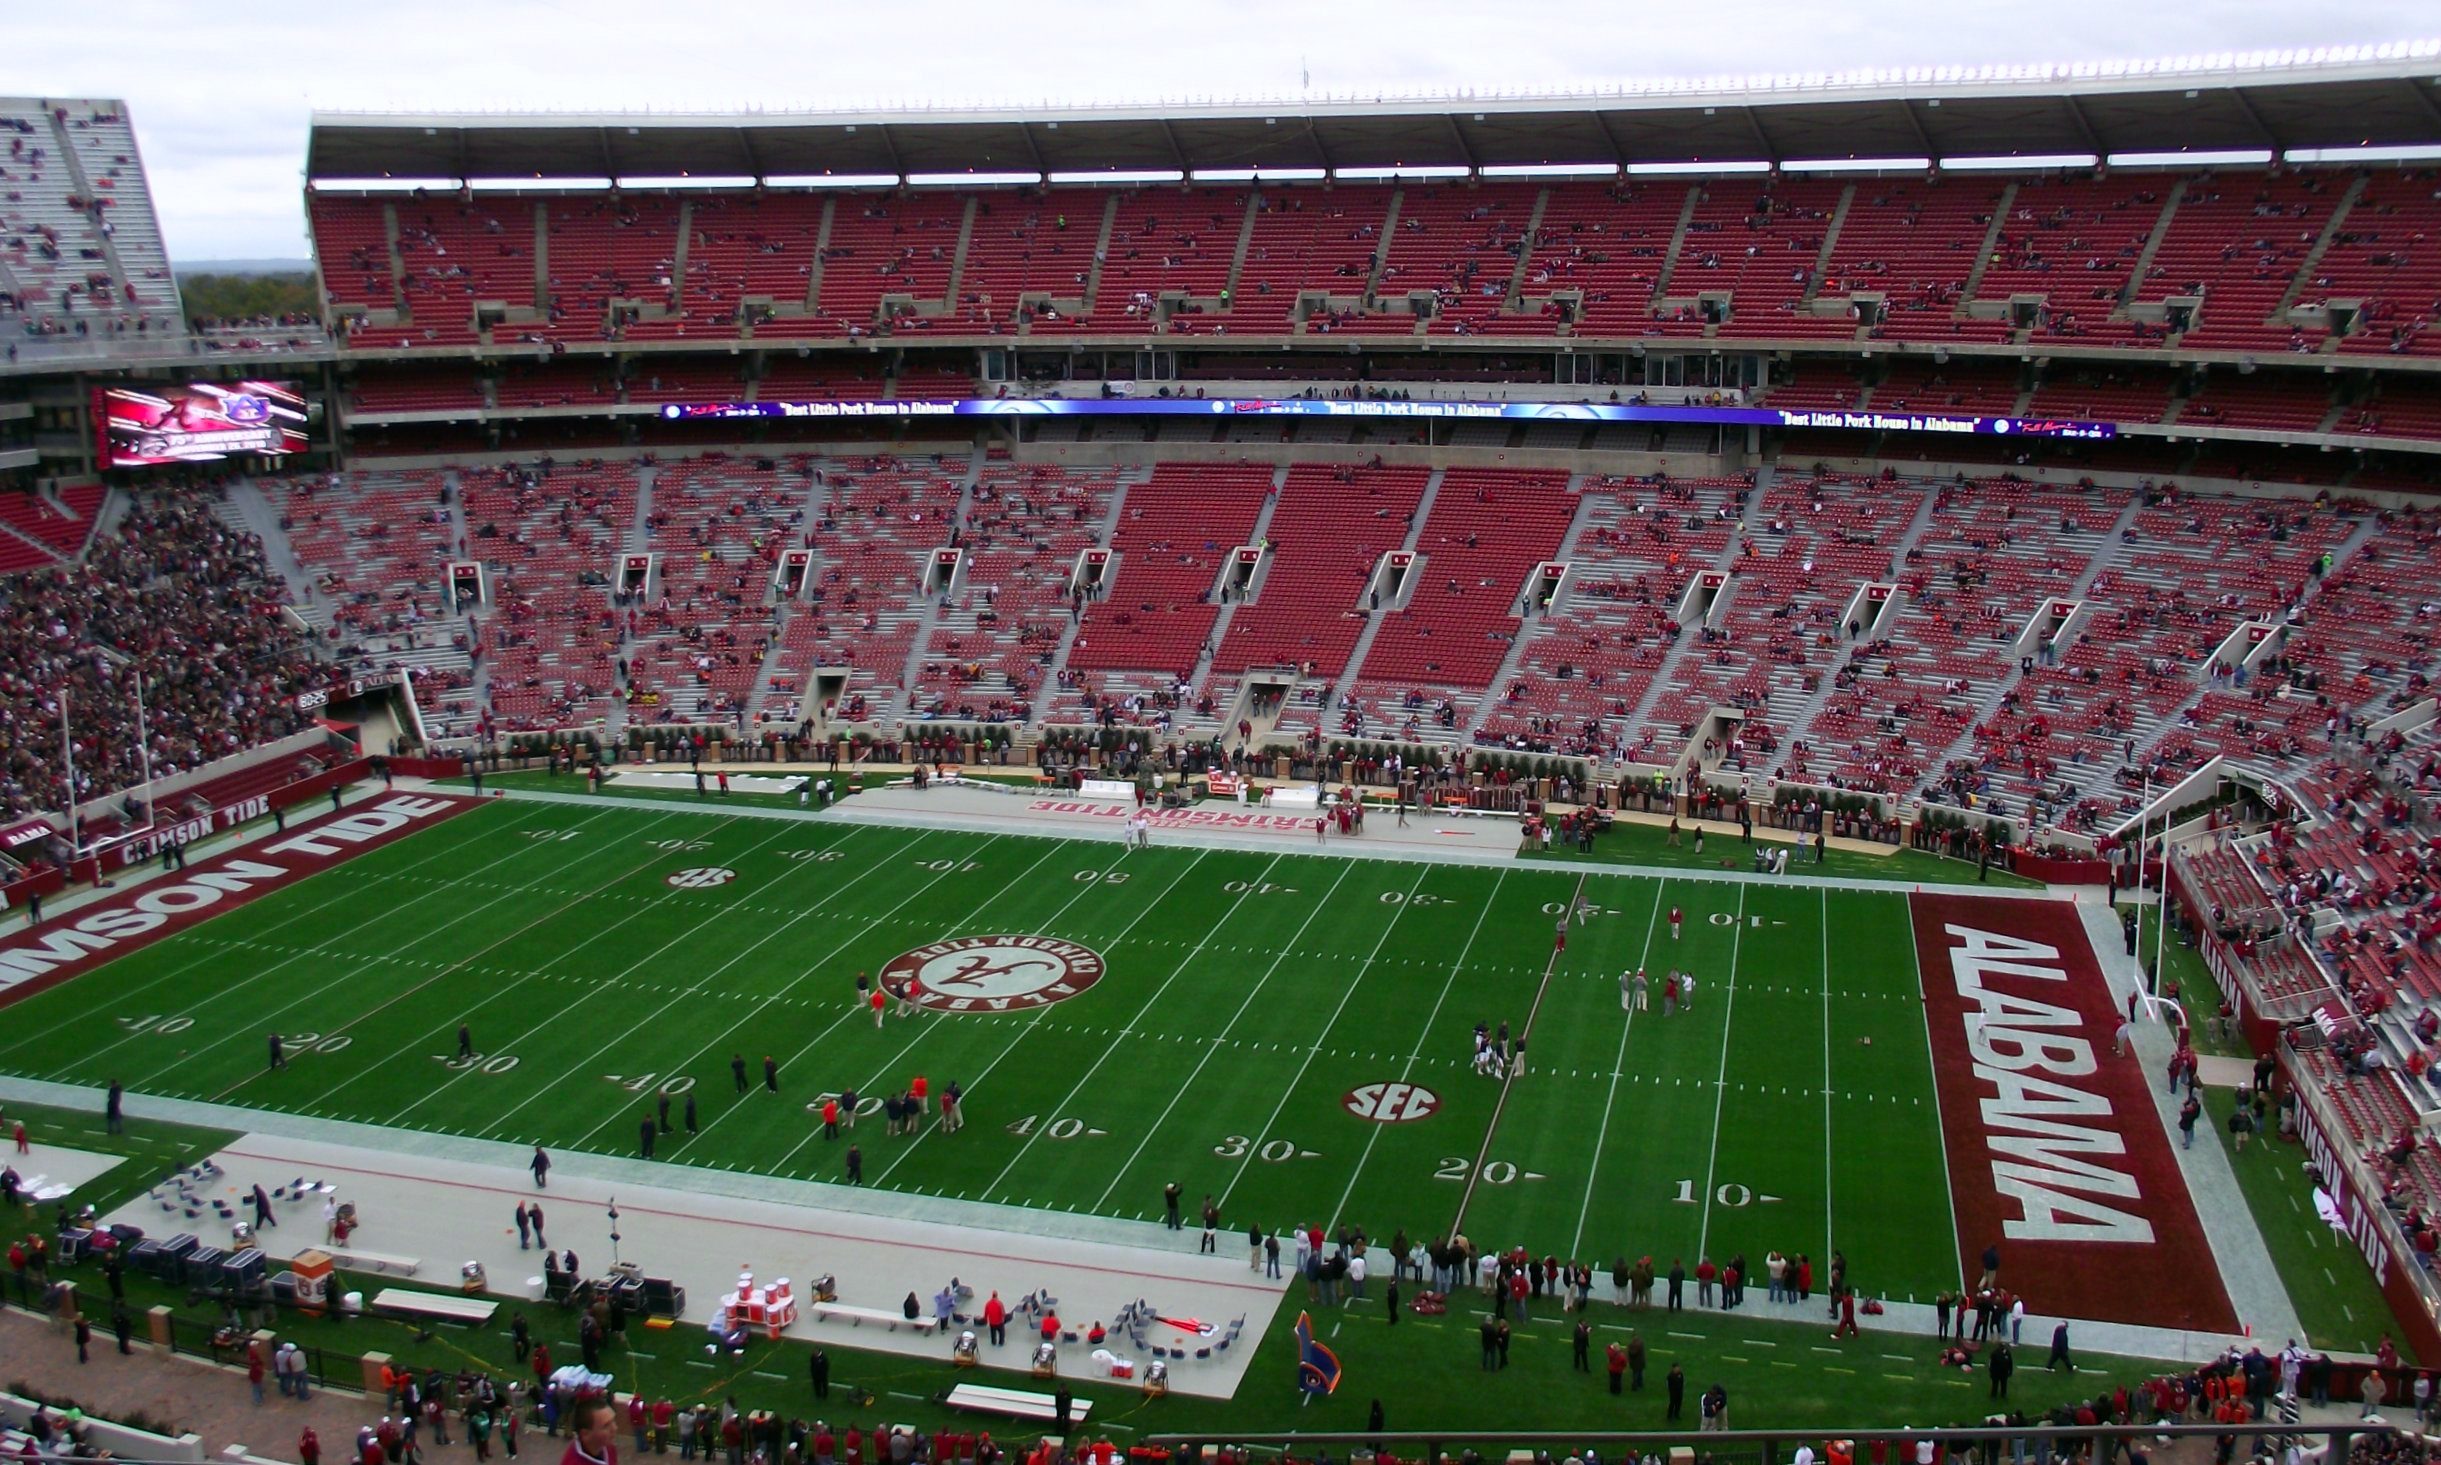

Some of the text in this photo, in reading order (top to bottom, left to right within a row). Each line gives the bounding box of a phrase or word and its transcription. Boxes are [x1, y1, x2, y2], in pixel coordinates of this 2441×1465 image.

[839, 402, 866, 415] Pork
[1811, 412, 1843, 427] Little
[1844, 413, 1873, 429] Pork
[223, 795, 271, 827] TIDE
[1028, 800, 1128, 818] TIDE
[7, 825, 53, 847] BAMA
[0, 794, 458, 992] IMSON TIDE
[130, 1013, 196, 1035] 10
[281, 1031, 354, 1054] 20
[445, 1050, 521, 1075] 30
[621, 1070, 697, 1096] 40
[1944, 922, 2157, 1244] ALABAMA
[1346, 1083, 1438, 1122] SEC
[1005, 1113, 1083, 1140] 40
[1212, 1134, 1296, 1163] 30
[1432, 1156, 1518, 1185] 20
[1671, 1178, 1752, 1207] 10
[2289, 1083, 2389, 1289] RIMSON TIDE
